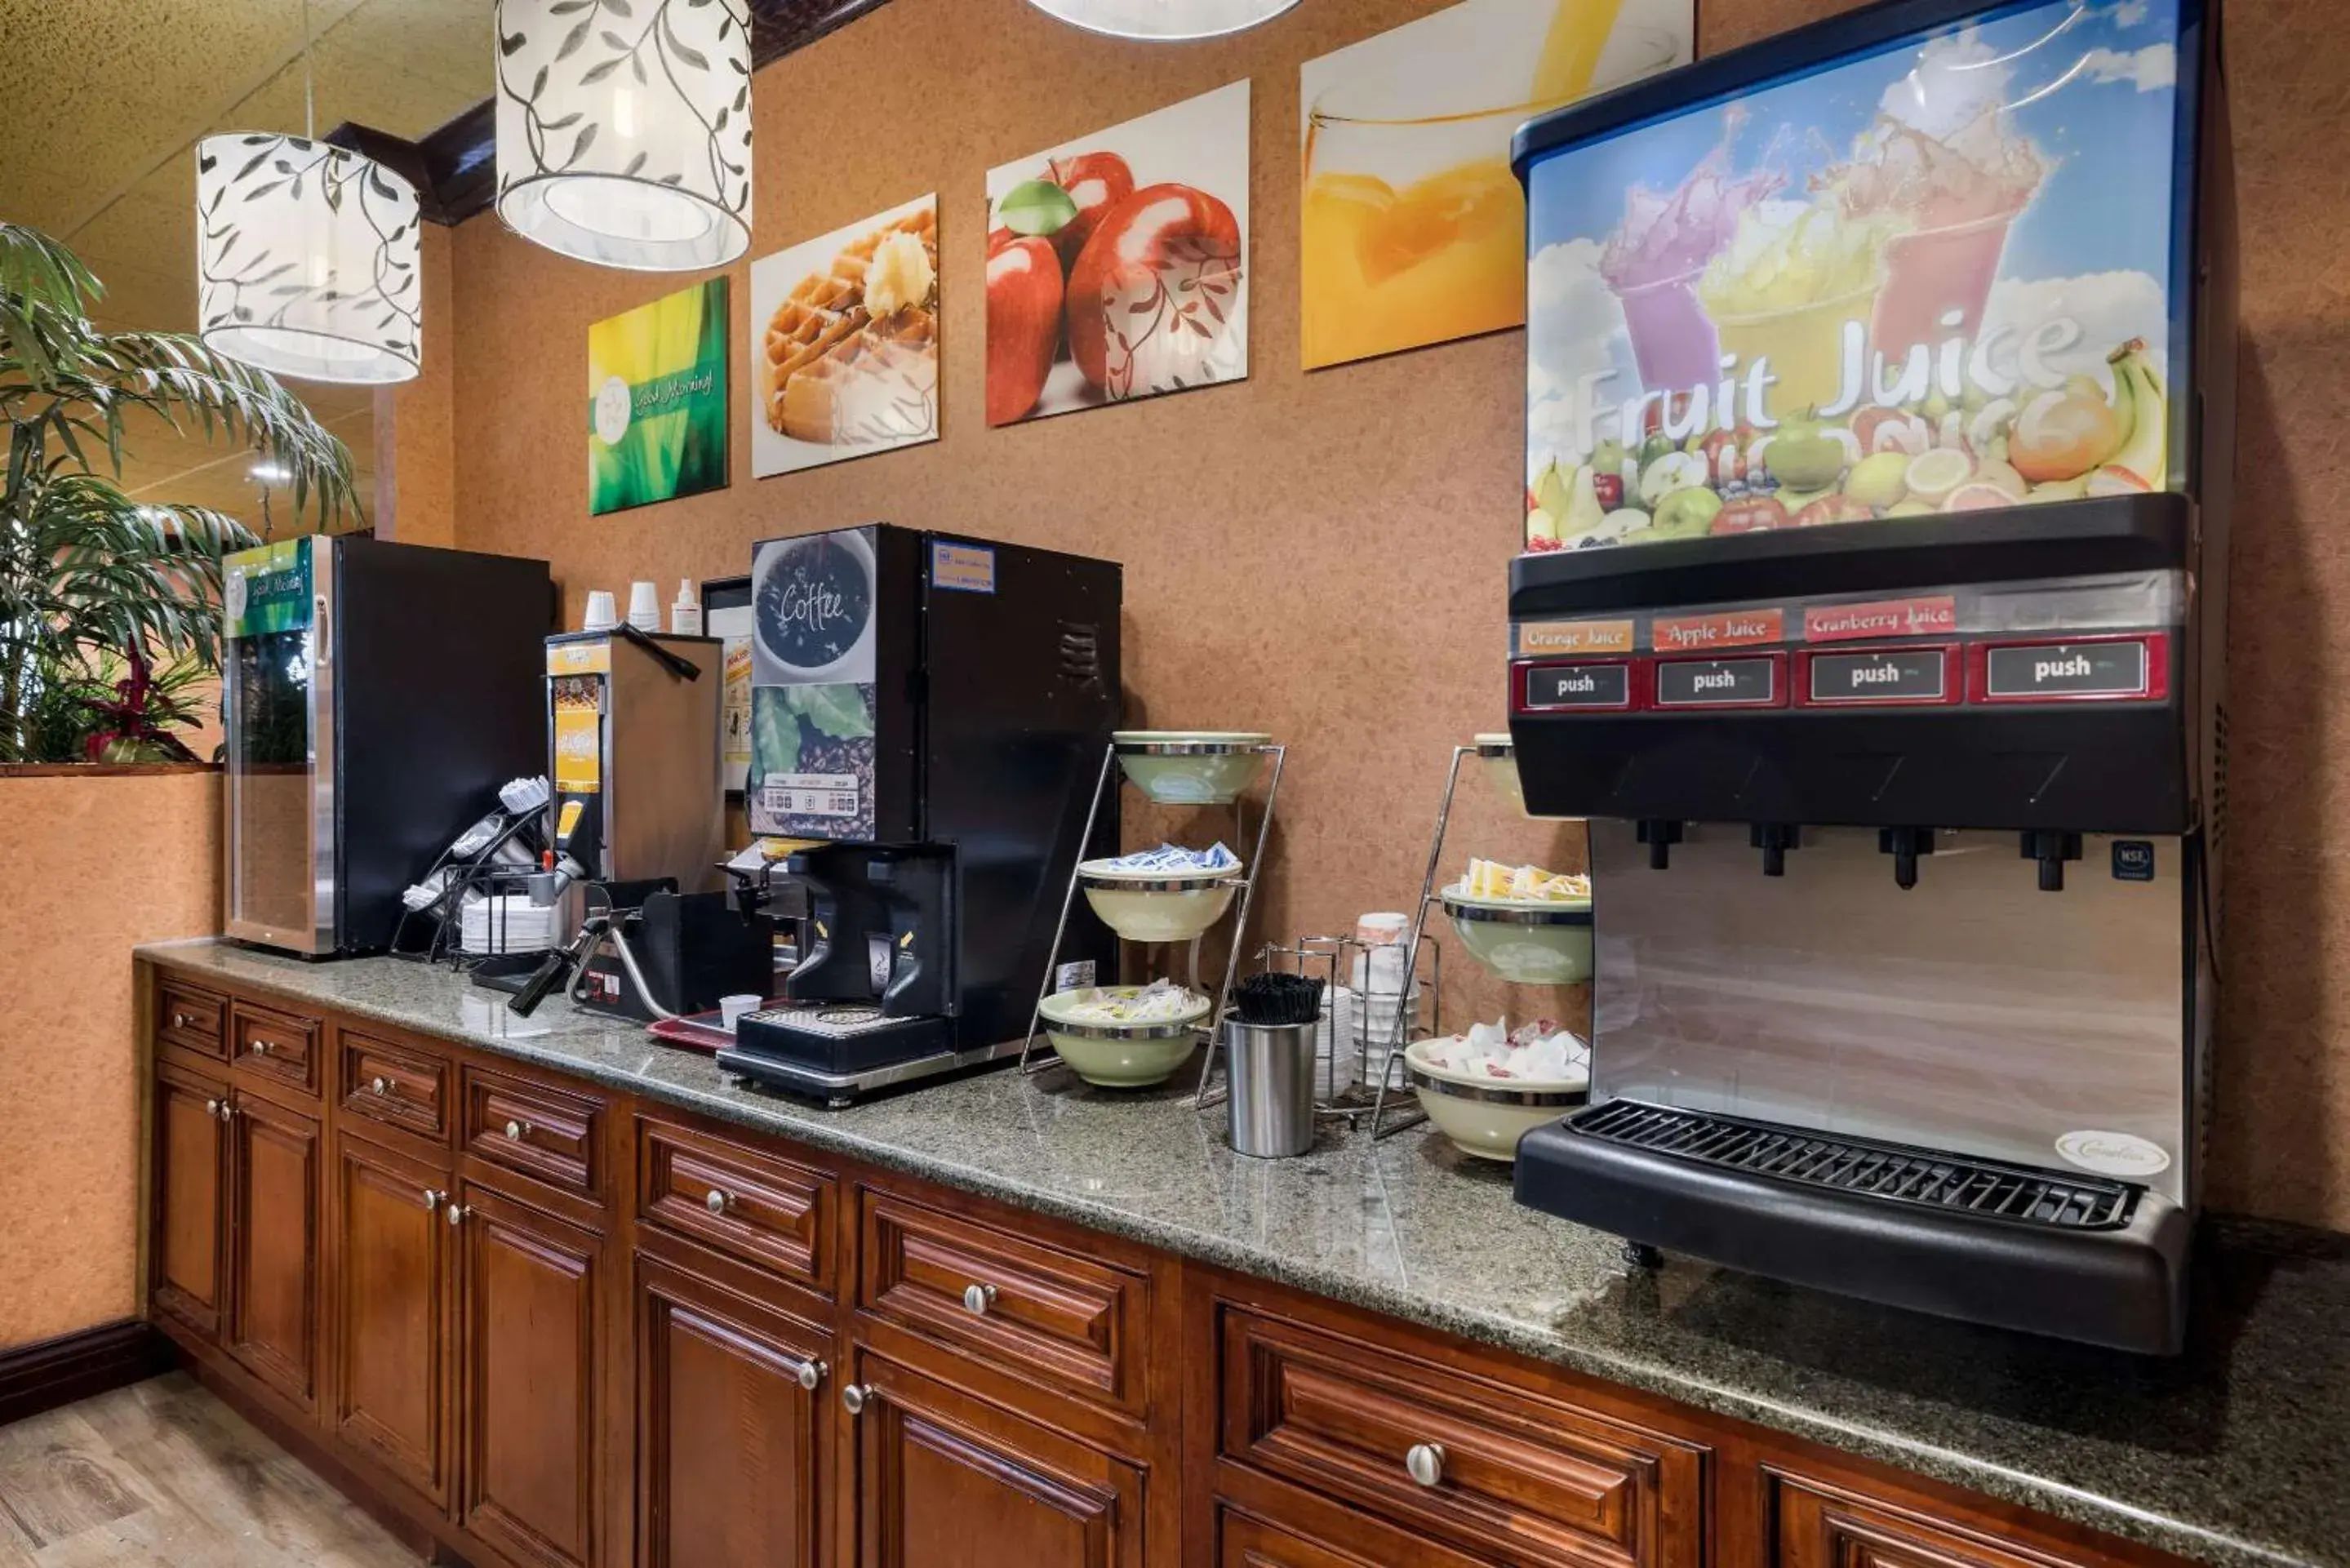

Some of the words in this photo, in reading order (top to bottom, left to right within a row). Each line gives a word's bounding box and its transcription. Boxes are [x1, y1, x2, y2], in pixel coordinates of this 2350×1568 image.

[1574, 353, 1779, 454] Fruit
[1818, 309, 2085, 419] Juice
[780, 582, 843, 632] Coffee
[1668, 624, 1717, 641] Apple
[1724, 620, 1766, 637] Juice
[1811, 612, 1899, 634] Cranberry
[1905, 607, 1951, 631] Juice
[1528, 629, 1580, 648] Orange
[1588, 629, 1624, 645] Juice
[1693, 669, 1735, 692] push
[1851, 662, 1899, 687] push
[2035, 655, 2091, 682] push
[1557, 675, 1594, 695] push
